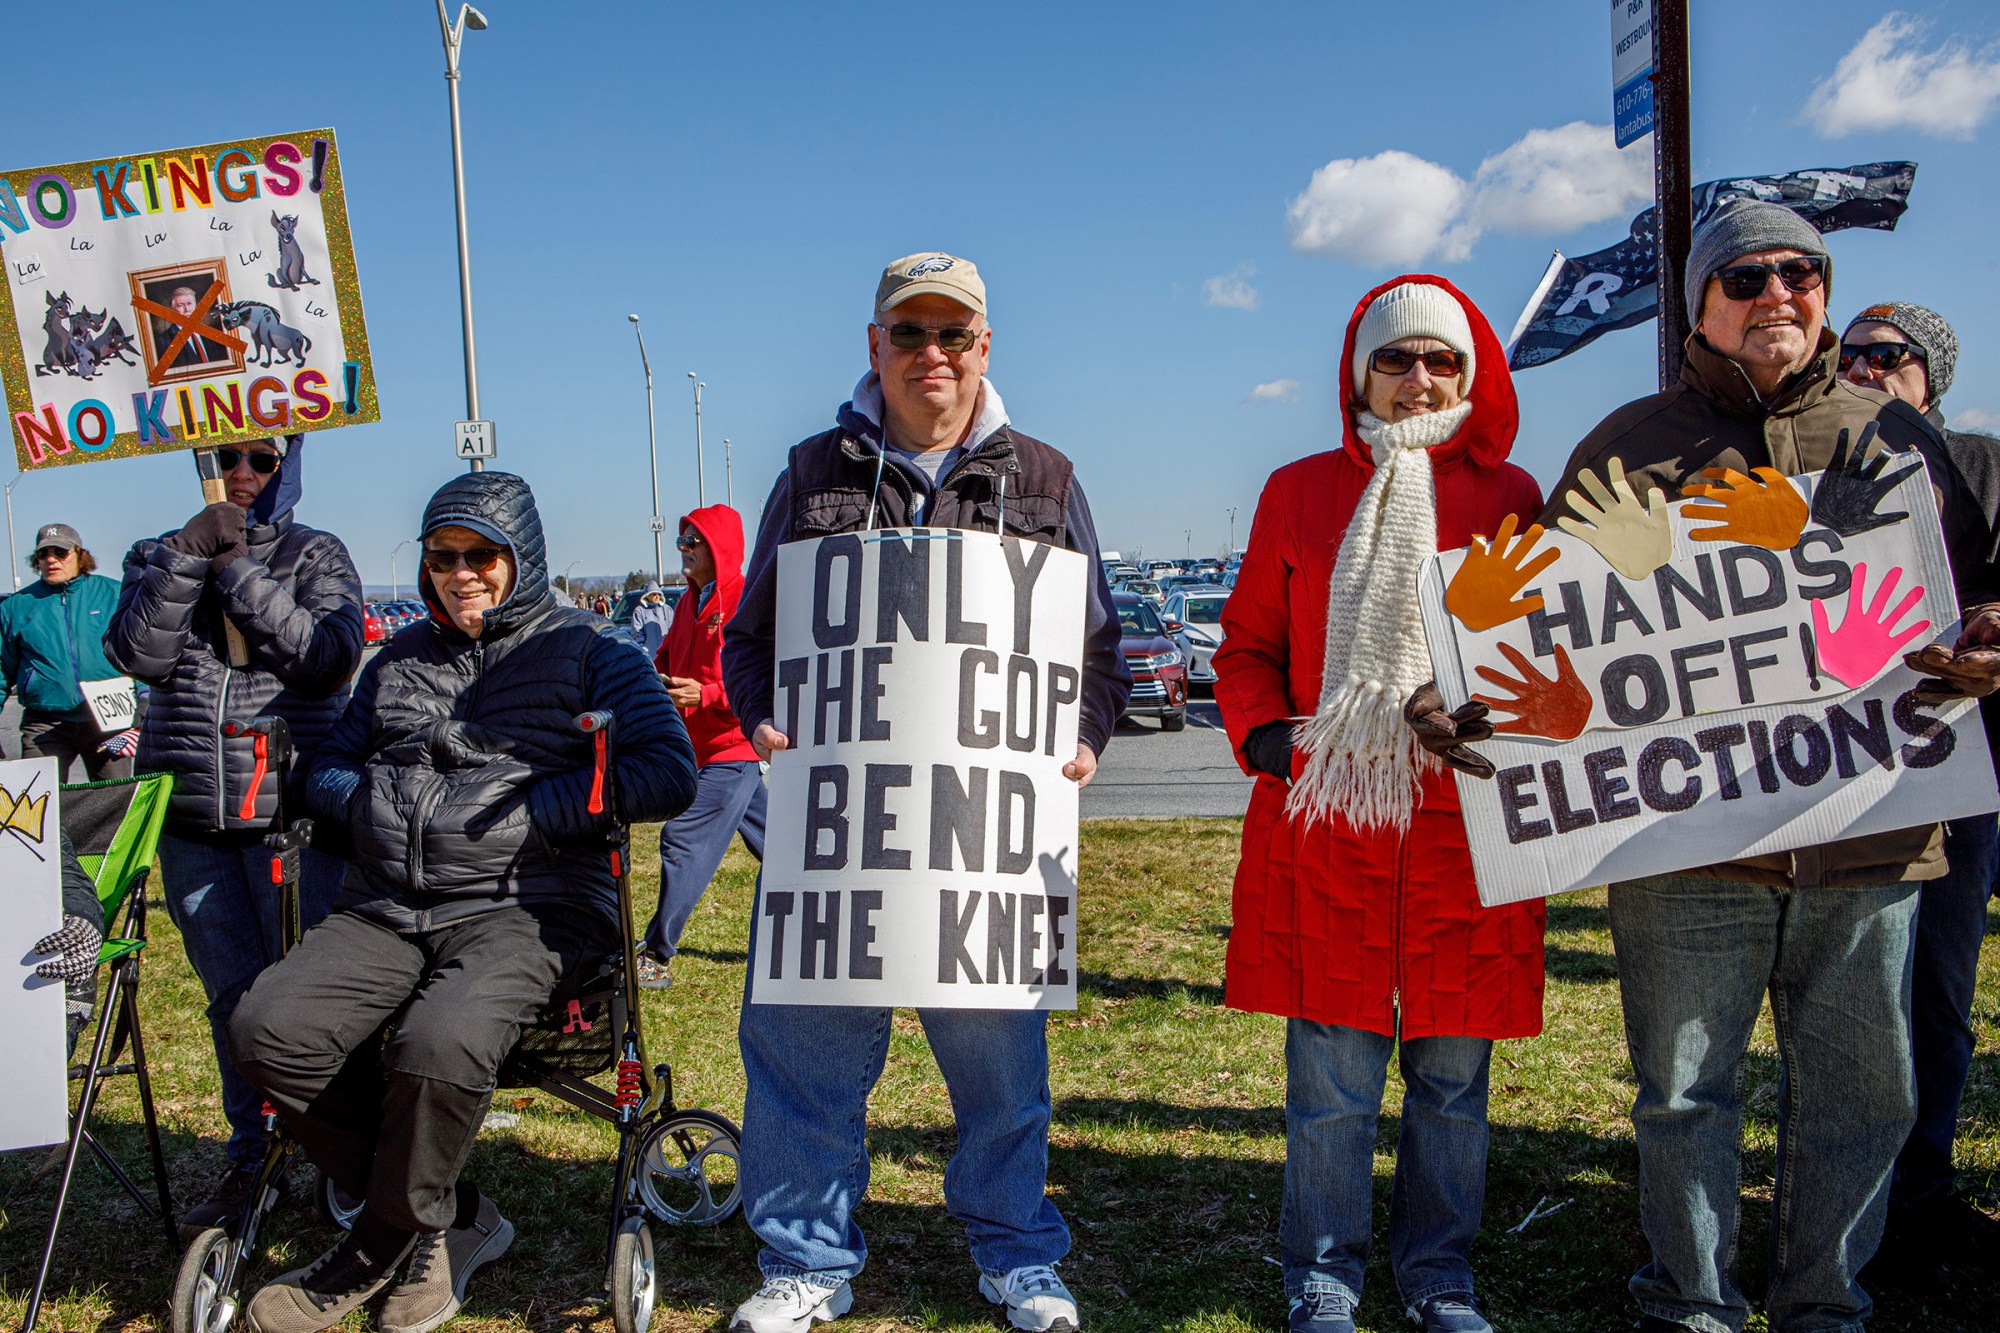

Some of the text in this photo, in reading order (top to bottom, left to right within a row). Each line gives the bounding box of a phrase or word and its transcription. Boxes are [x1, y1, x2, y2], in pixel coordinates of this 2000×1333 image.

[1616, 82, 1653, 116] 610-776-
[0, 138, 330, 241] NO KINGS!
[70, 237, 94, 250] La
[145, 232, 167, 248] La
[210, 216, 233, 231] La
[17, 262, 40, 276] La
[239, 250, 262, 266] La
[305, 300, 328, 318] La
[15, 361, 361, 464] NO KINGS!
[463, 424, 482, 434] LOT
[462, 437, 484, 454] A1
[812, 529, 1052, 655] ONLY
[1522, 528, 1852, 658] HANDS
[778, 647, 1079, 757] THE GOP
[1600, 622, 1821, 727] OFF!
[1496, 689, 1957, 845] ELECTIONS
[803, 763, 1037, 874] BEND
[764, 889, 1070, 986] THE KNEE
